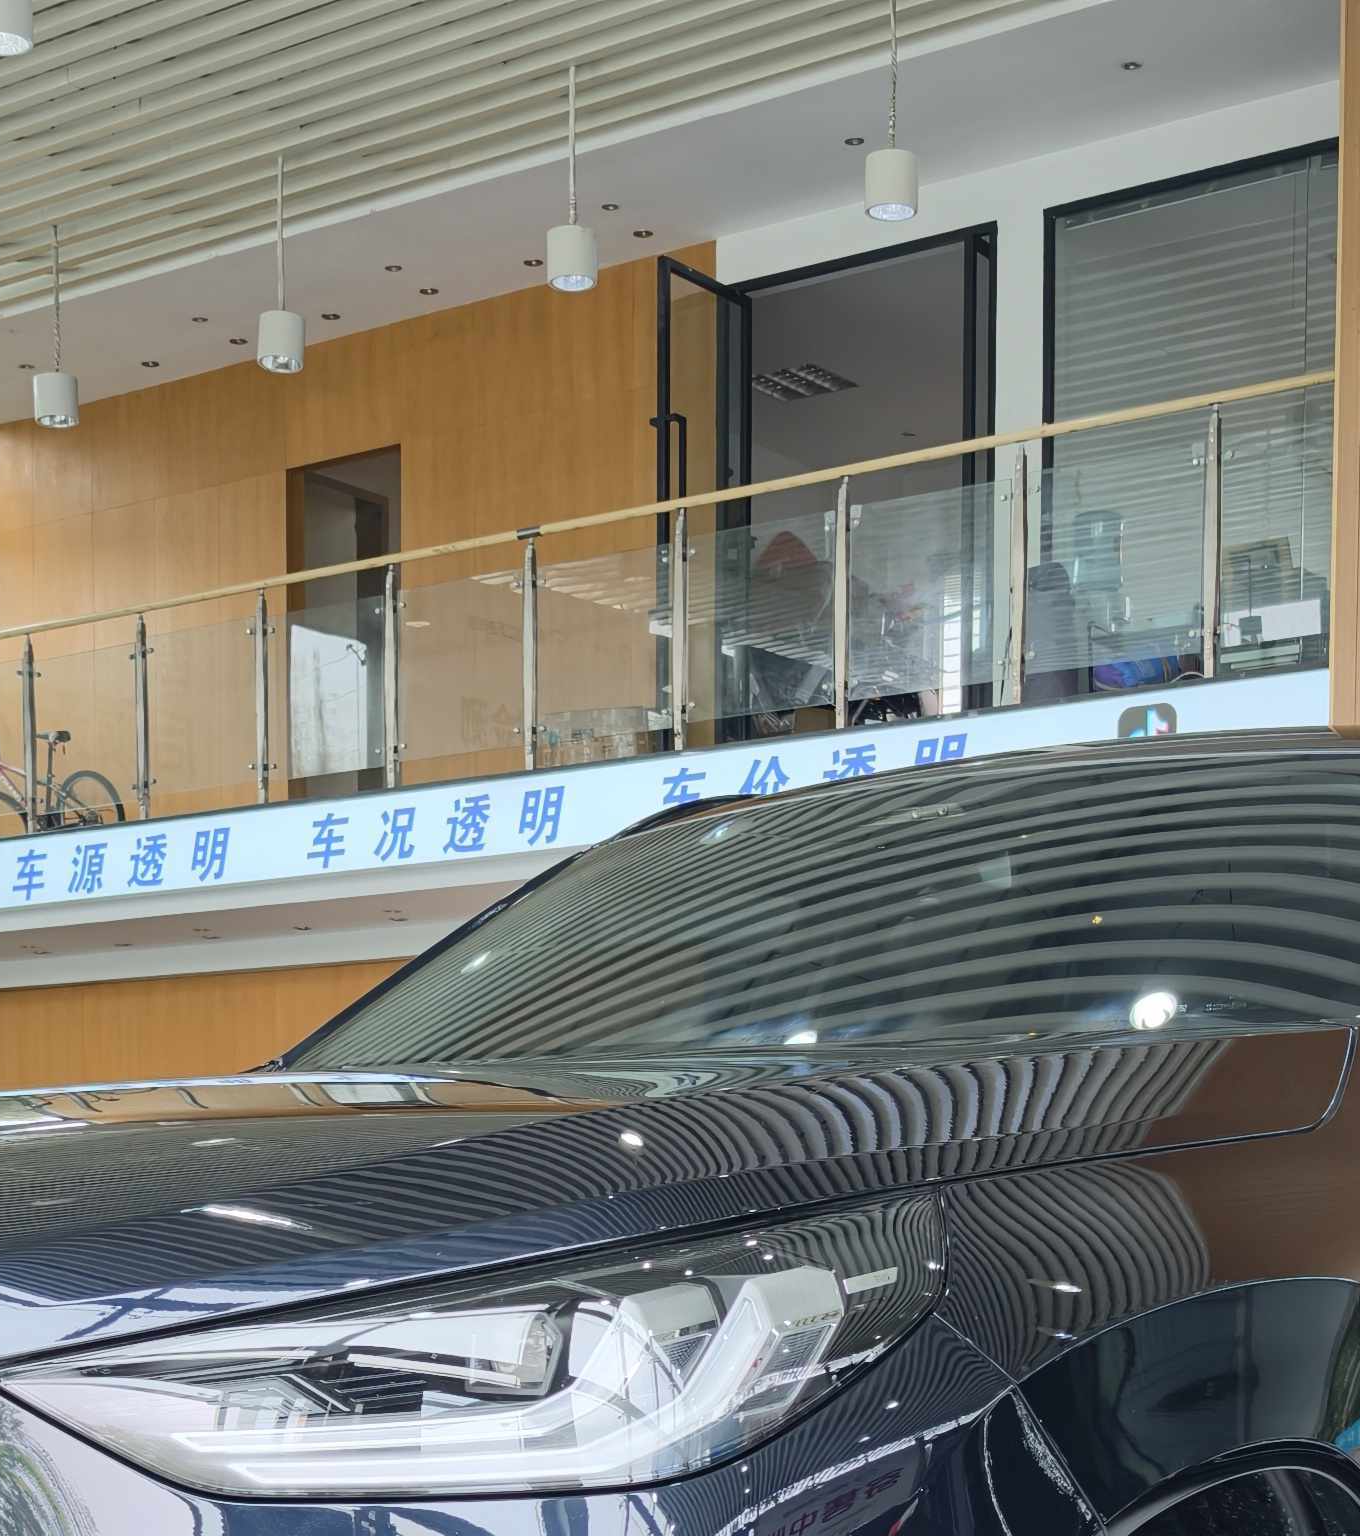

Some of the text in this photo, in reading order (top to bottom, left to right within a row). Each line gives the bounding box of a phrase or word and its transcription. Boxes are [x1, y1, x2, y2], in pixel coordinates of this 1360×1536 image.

[12, 826, 232, 902] 车源透明
[307, 785, 566, 871] 车况透明
